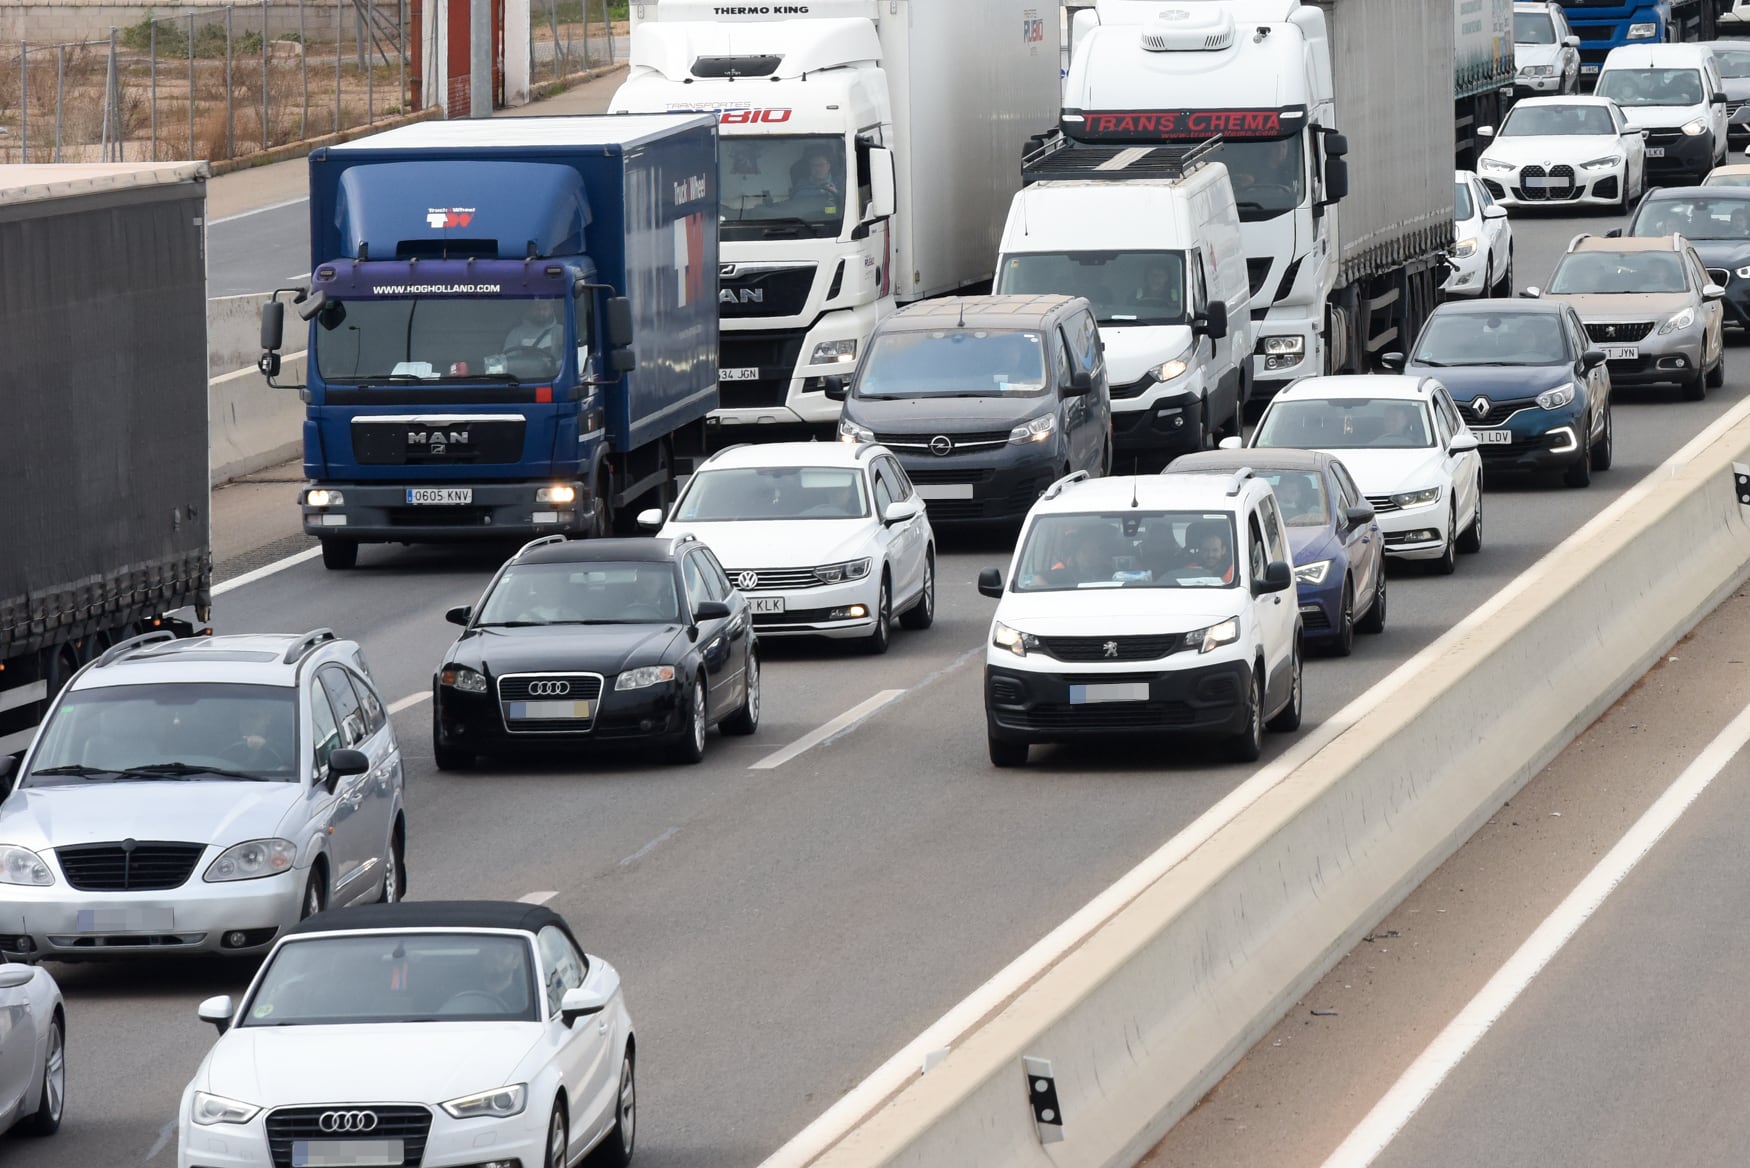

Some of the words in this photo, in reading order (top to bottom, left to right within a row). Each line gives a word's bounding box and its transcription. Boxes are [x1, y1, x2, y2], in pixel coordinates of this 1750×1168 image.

[713, 7, 770, 15] THERMO
[773, 6, 809, 14] KING
[666, 108, 792, 124] BIO
[1083, 112, 1181, 132] TRANS
[1187, 111, 1281, 131] CHEMA
[373, 284, 501, 294] WWW.HOGHOLLAND.COM
[1618, 349, 1635, 358] JYN
[737, 369, 757, 379] JGN
[408, 431, 469, 444] MAN
[1488, 431, 1509, 442] LDV
[415, 490, 444, 502] 0605
[447, 490, 469, 501] KNV
[757, 599, 780, 611] KLK
